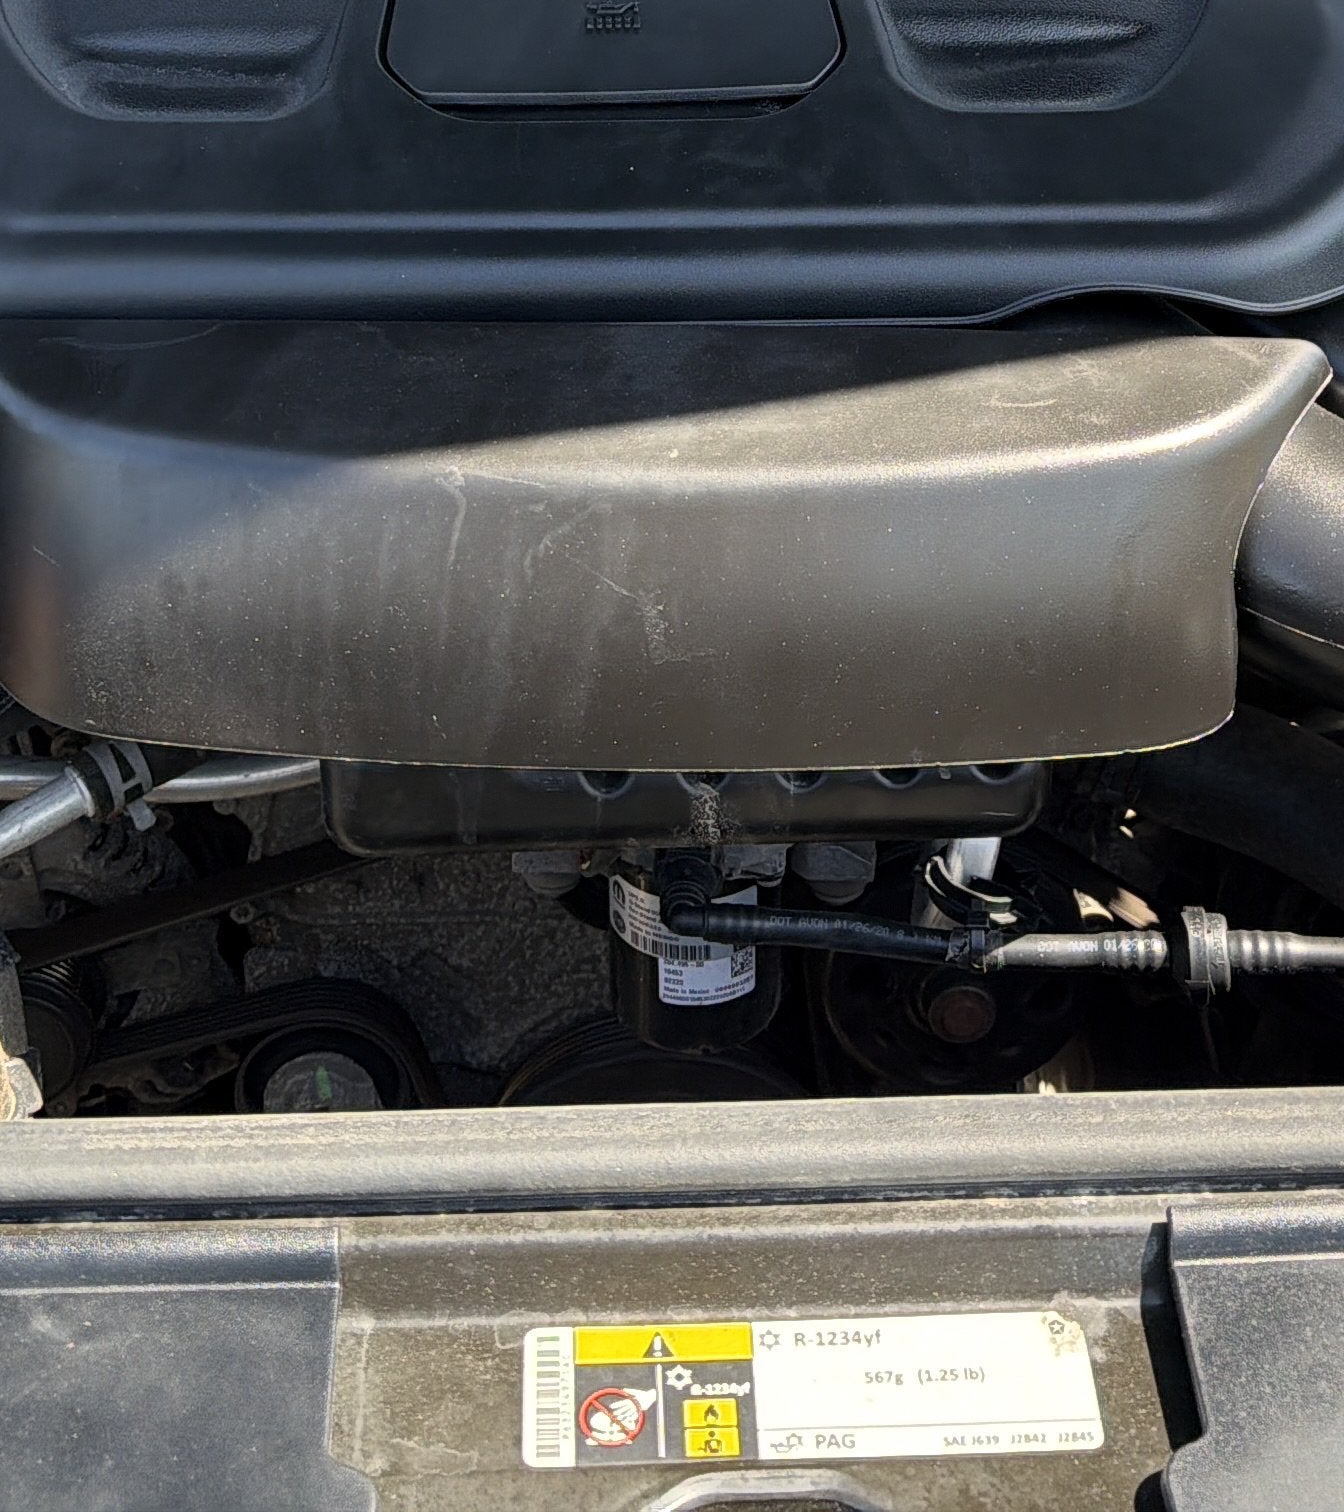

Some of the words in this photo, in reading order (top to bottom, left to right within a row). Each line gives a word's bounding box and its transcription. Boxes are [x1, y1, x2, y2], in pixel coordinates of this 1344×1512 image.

[793, 1328, 882, 1350] R-1234yf
[863, 1368, 905, 1387] 567g
[917, 1367, 960, 1386] (1.25
[961, 1366, 987, 1385] lb)
[814, 1432, 857, 1450] PAG
[943, 1435, 966, 1448] SAE
